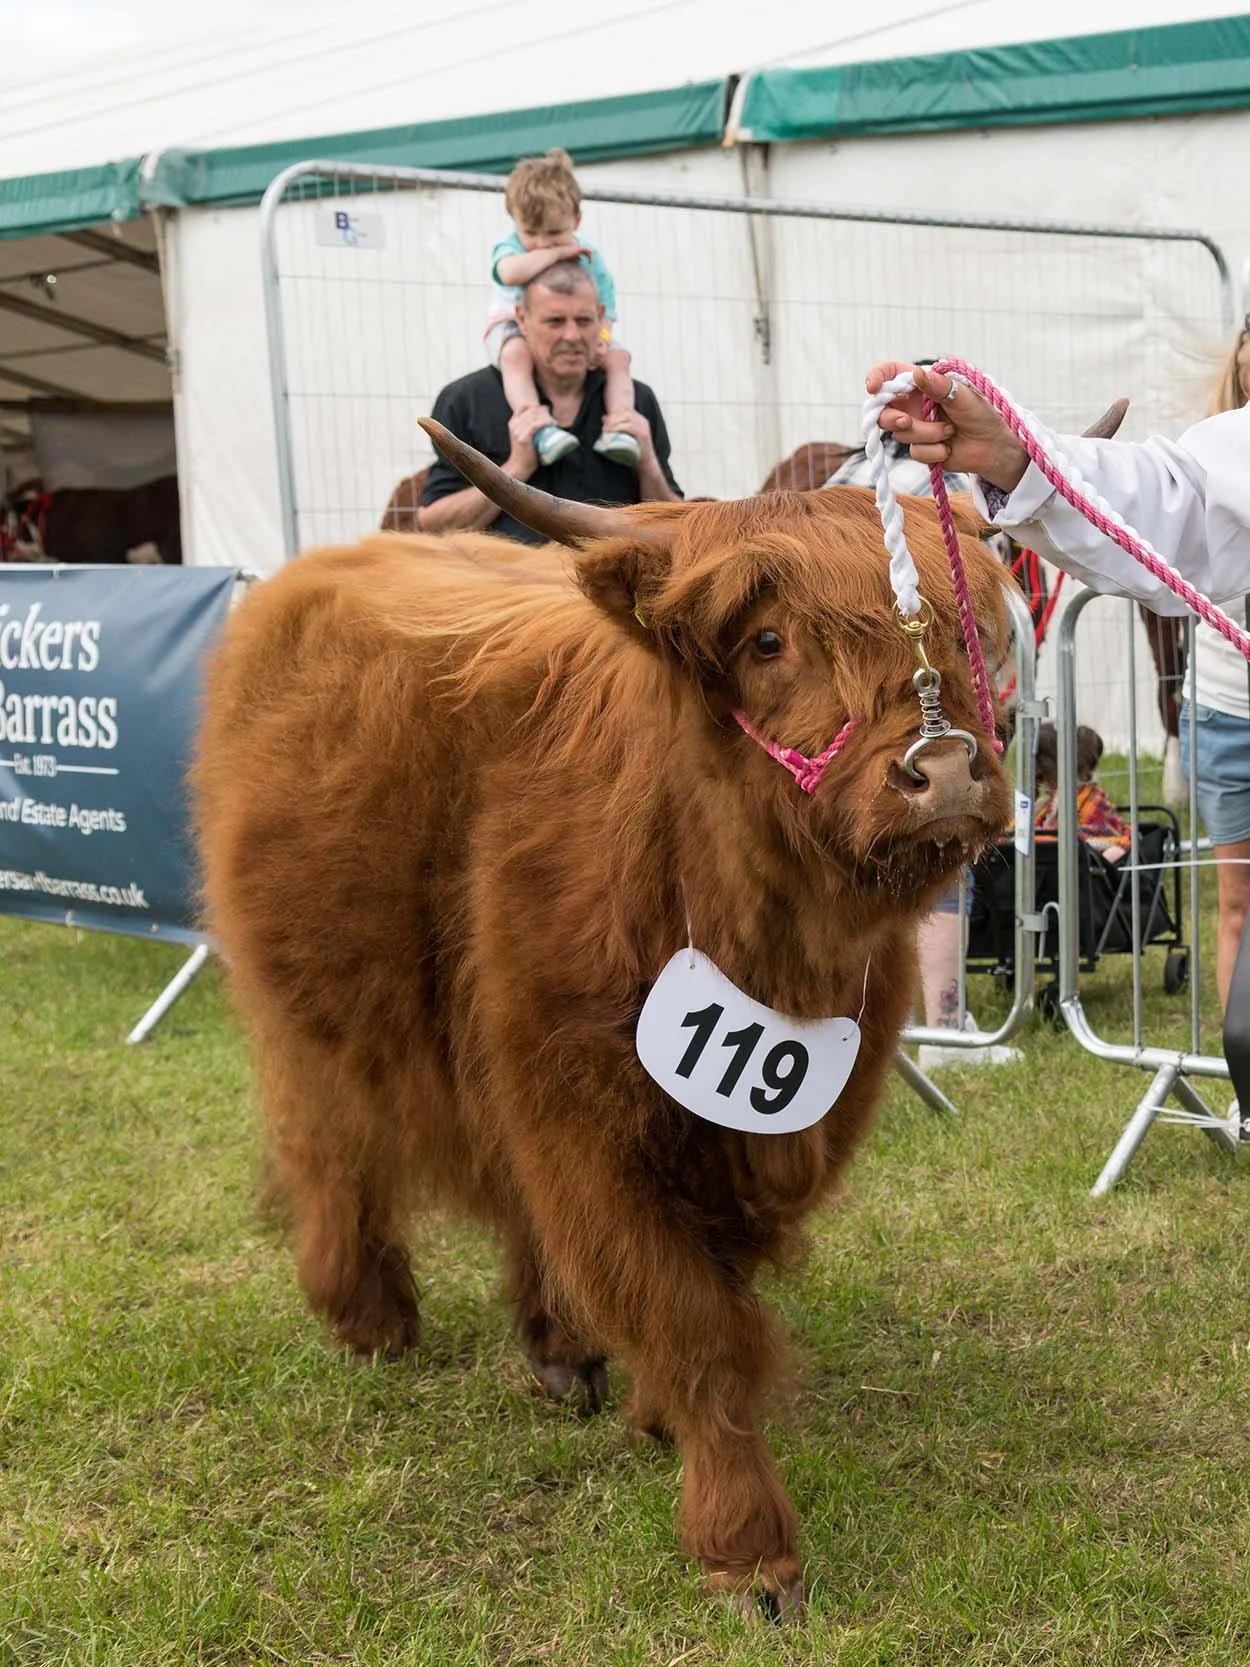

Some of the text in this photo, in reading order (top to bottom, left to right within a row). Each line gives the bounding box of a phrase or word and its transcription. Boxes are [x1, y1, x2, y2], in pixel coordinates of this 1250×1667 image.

[0, 602, 101, 672] ckers
[21, 797, 68, 828] Estate
[68, 803, 127, 836] Agents
[674, 1002, 810, 1115] 119
